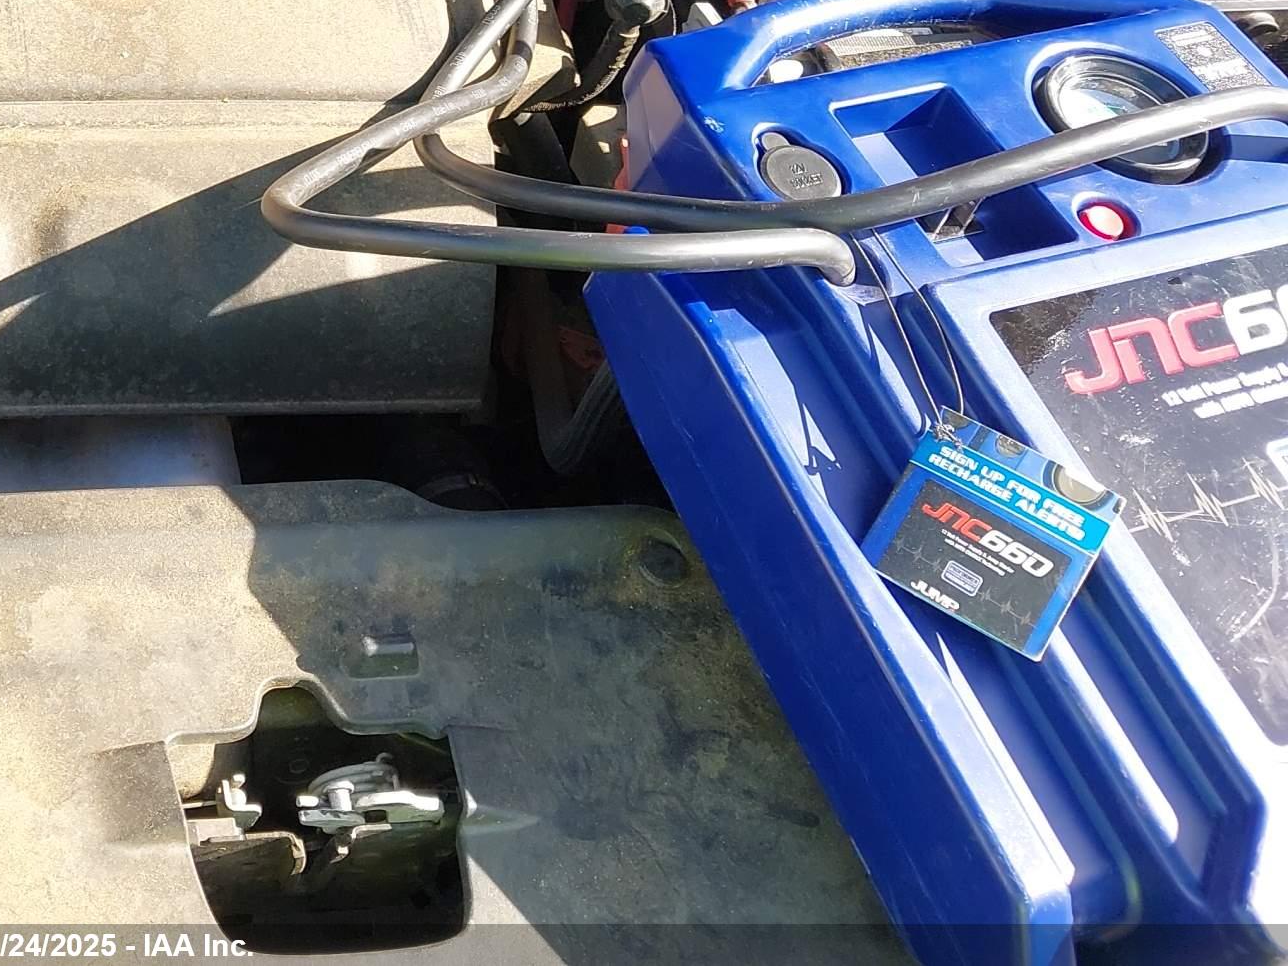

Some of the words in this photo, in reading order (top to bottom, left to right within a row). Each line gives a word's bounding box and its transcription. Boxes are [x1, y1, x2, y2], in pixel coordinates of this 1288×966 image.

[928, 453, 1013, 503] RECHARGE
[940, 446, 978, 471] SIGN
[980, 465, 1005, 482] UP
[1007, 479, 1042, 504] FOR
[1042, 497, 1086, 526] FREE
[922, 502, 1055, 578] JNC660
[910, 579, 960, 611] JUMP
